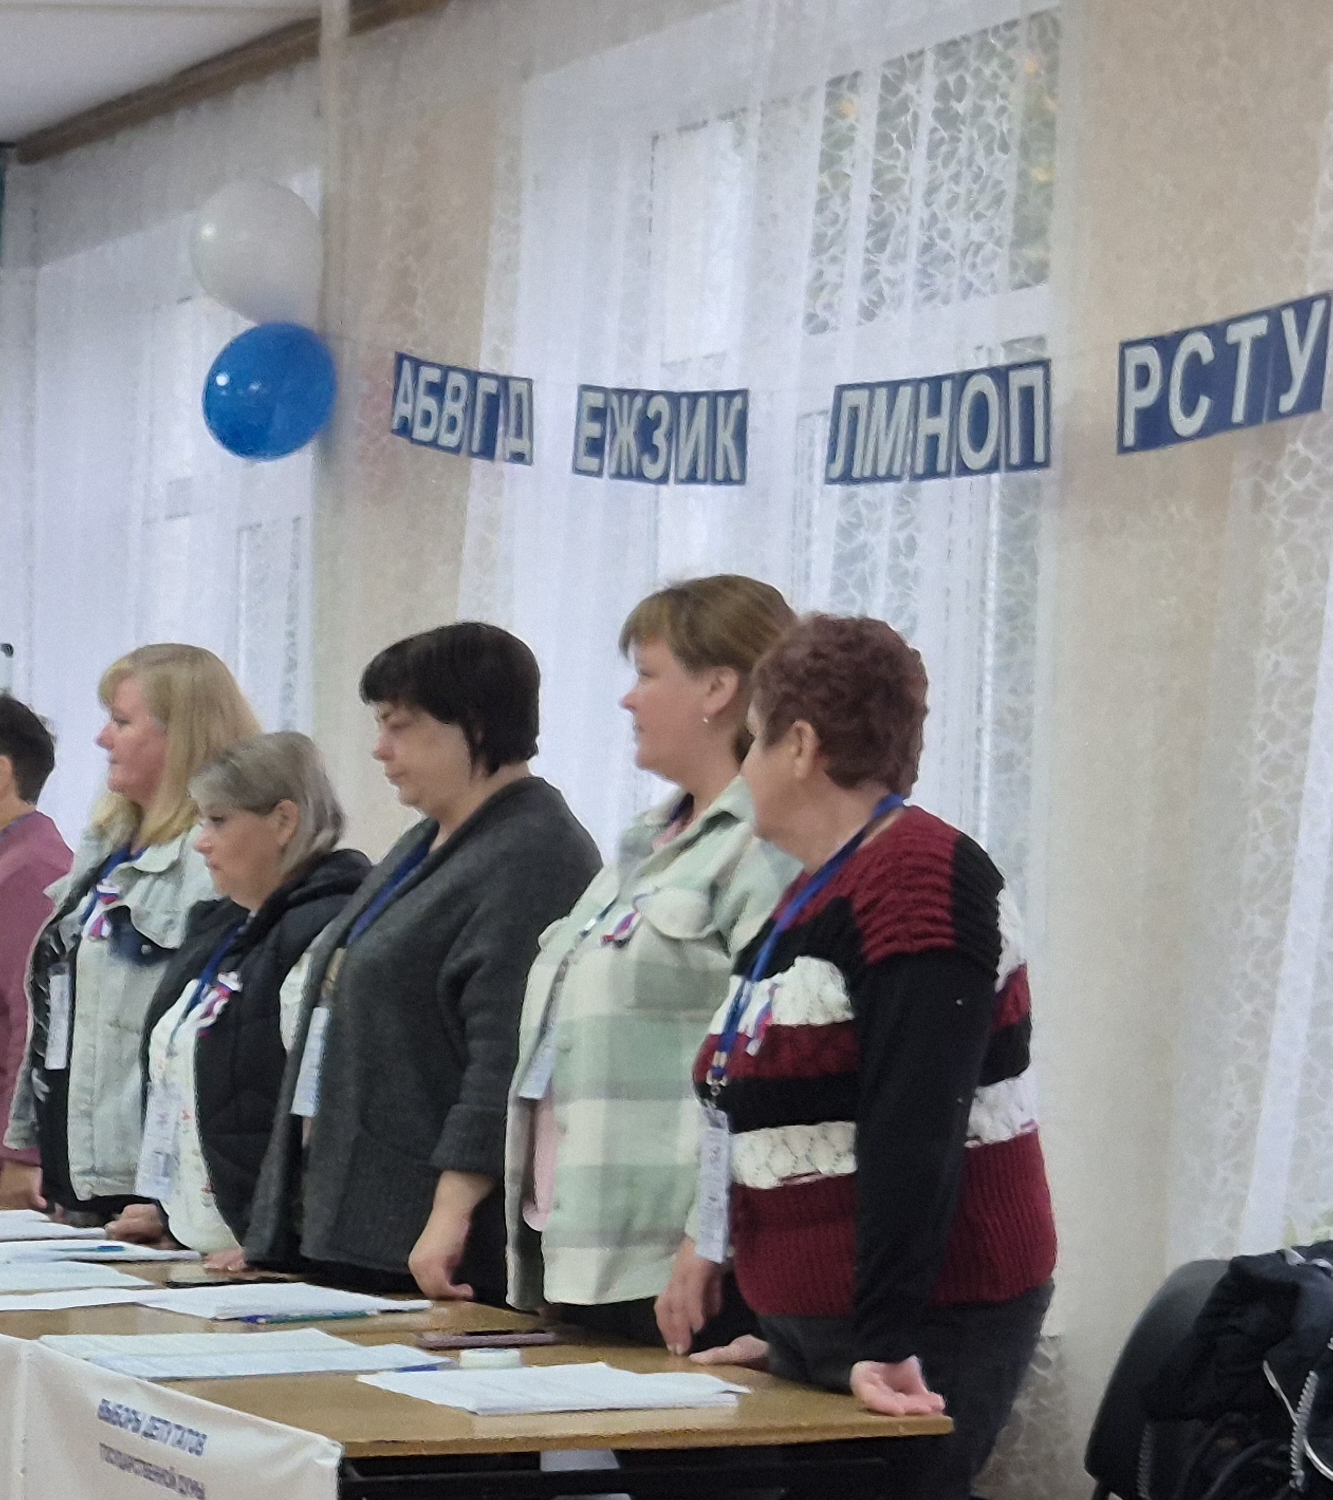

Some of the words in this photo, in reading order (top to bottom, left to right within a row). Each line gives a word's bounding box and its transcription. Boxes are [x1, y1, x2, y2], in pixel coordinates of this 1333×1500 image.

[391, 358, 532, 464] АБВГД
[826, 368, 1047, 479] ЛМНОП
[1122, 299, 1327, 448] РСТУ
[581, 391, 743, 481] ЕЖЗИК
